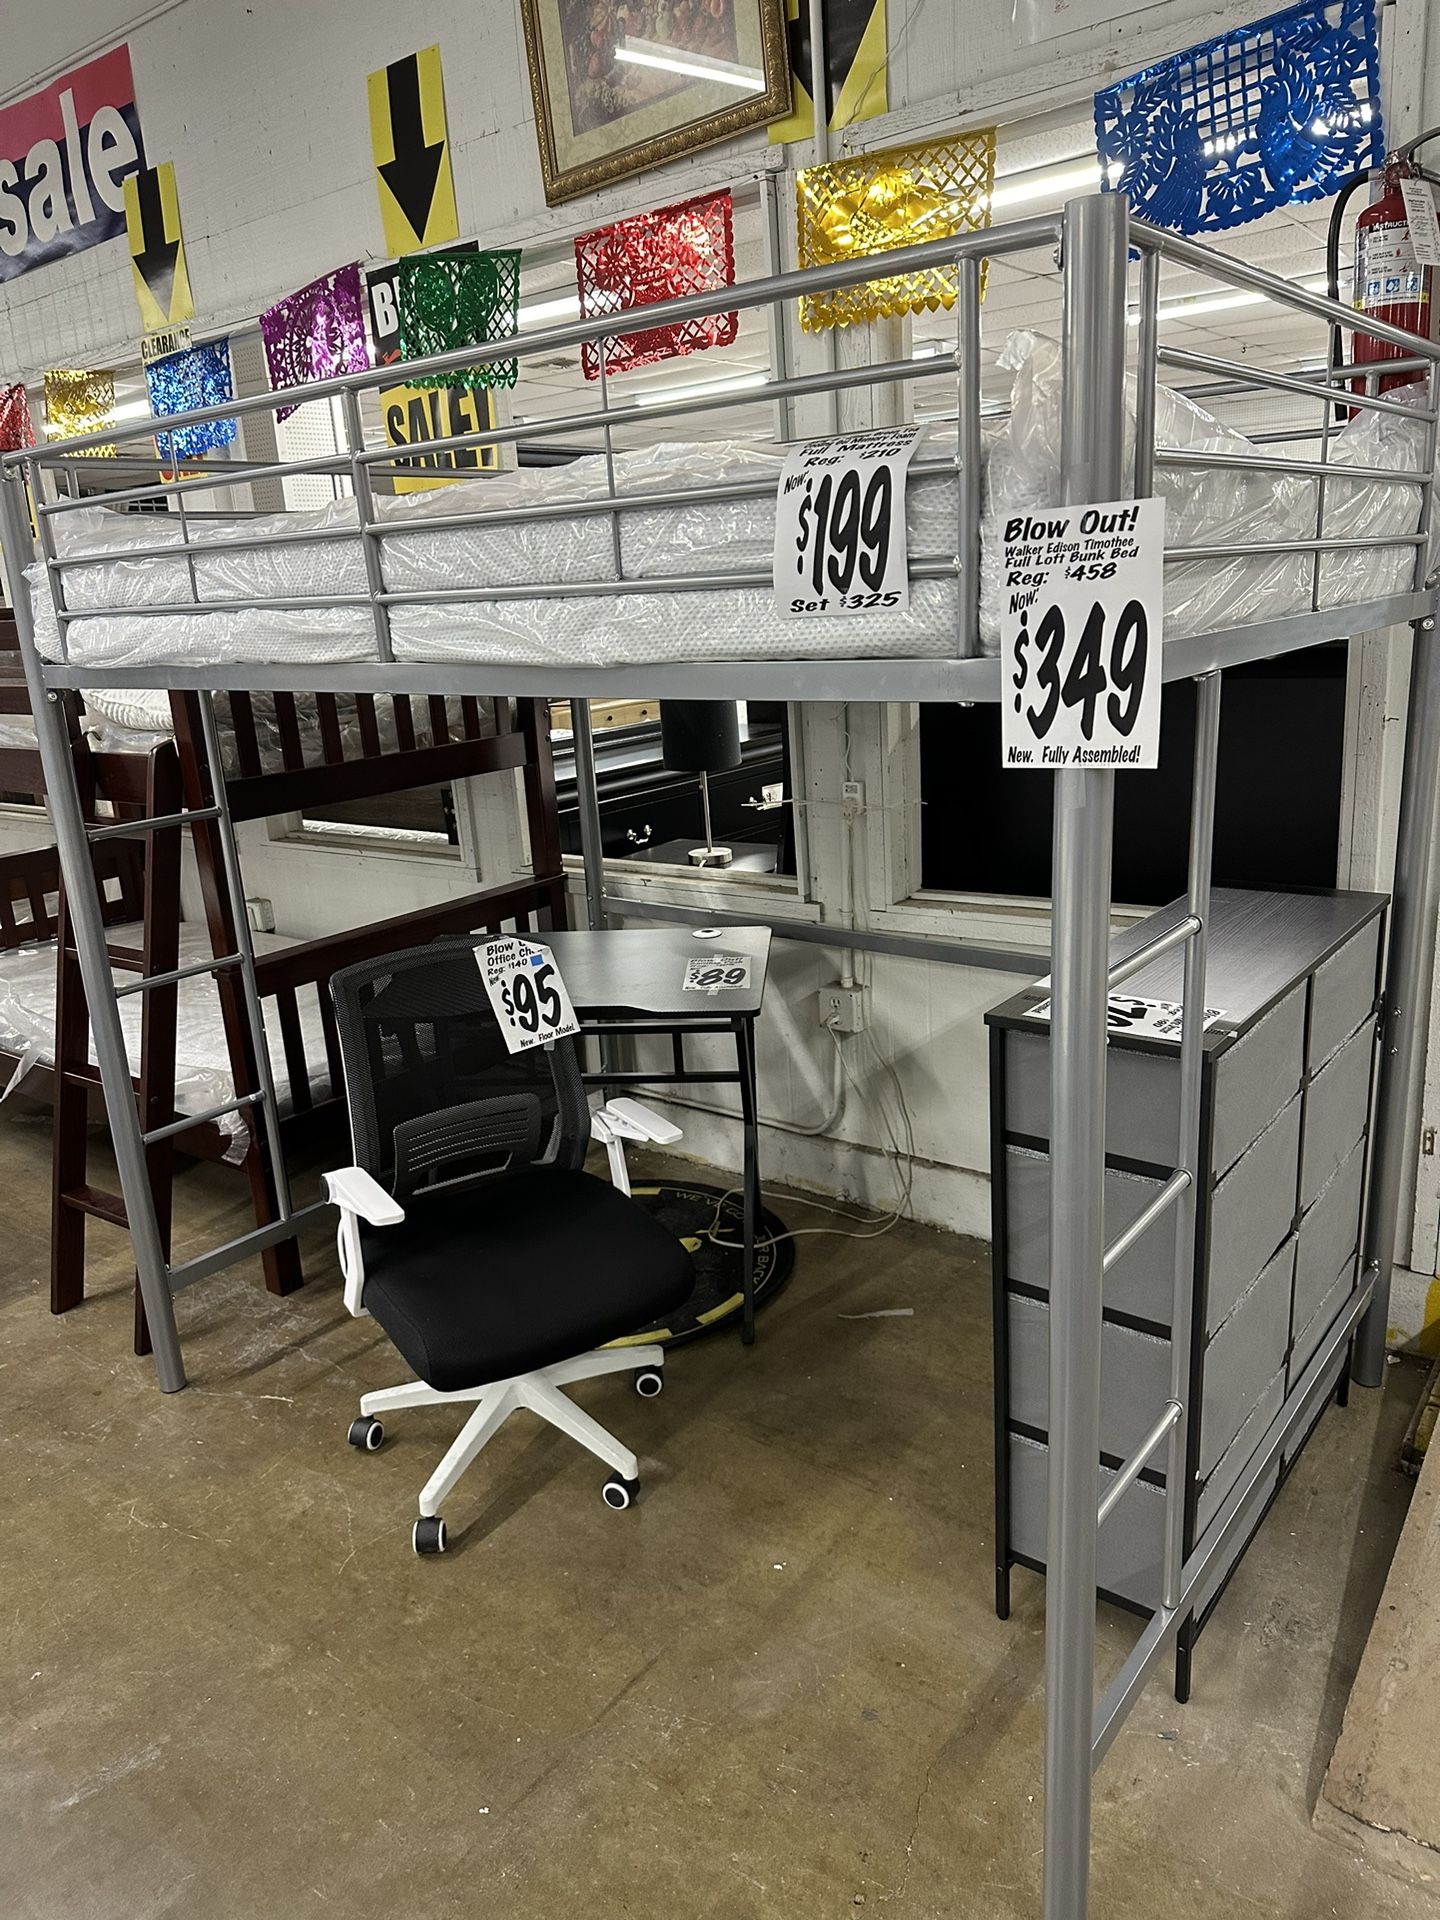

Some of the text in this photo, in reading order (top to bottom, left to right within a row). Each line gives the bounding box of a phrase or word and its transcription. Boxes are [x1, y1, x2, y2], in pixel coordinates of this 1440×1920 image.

[0, 87, 139, 256] sale
[141, 328, 190, 360] CLEARANCE
[387, 388, 495, 468] SALE!
[800, 440, 913, 457] Full Mattress
[803, 448, 902, 467] Reg: $210
[783, 470, 810, 495] Now:
[796, 464, 892, 597] $199
[1003, 505, 1140, 543] Blow Out!
[1004, 536, 1135, 558] Walker Edison Timothee
[1005, 546, 1140, 569] Full Loft Bunk Bed
[1006, 562, 1118, 588] Reg: $458
[790, 591, 902, 613] Set $325
[1009, 588, 1040, 615] Now:
[1012, 599, 1148, 742] $349
[1007, 744, 1142, 765] New. Fully Assembled!
[486, 942, 514, 957] Blow
[487, 953, 516, 967] Office
[689, 967, 747, 986] $89
[501, 963, 562, 1034] $95
[538, 1031, 554, 1042] Floor
